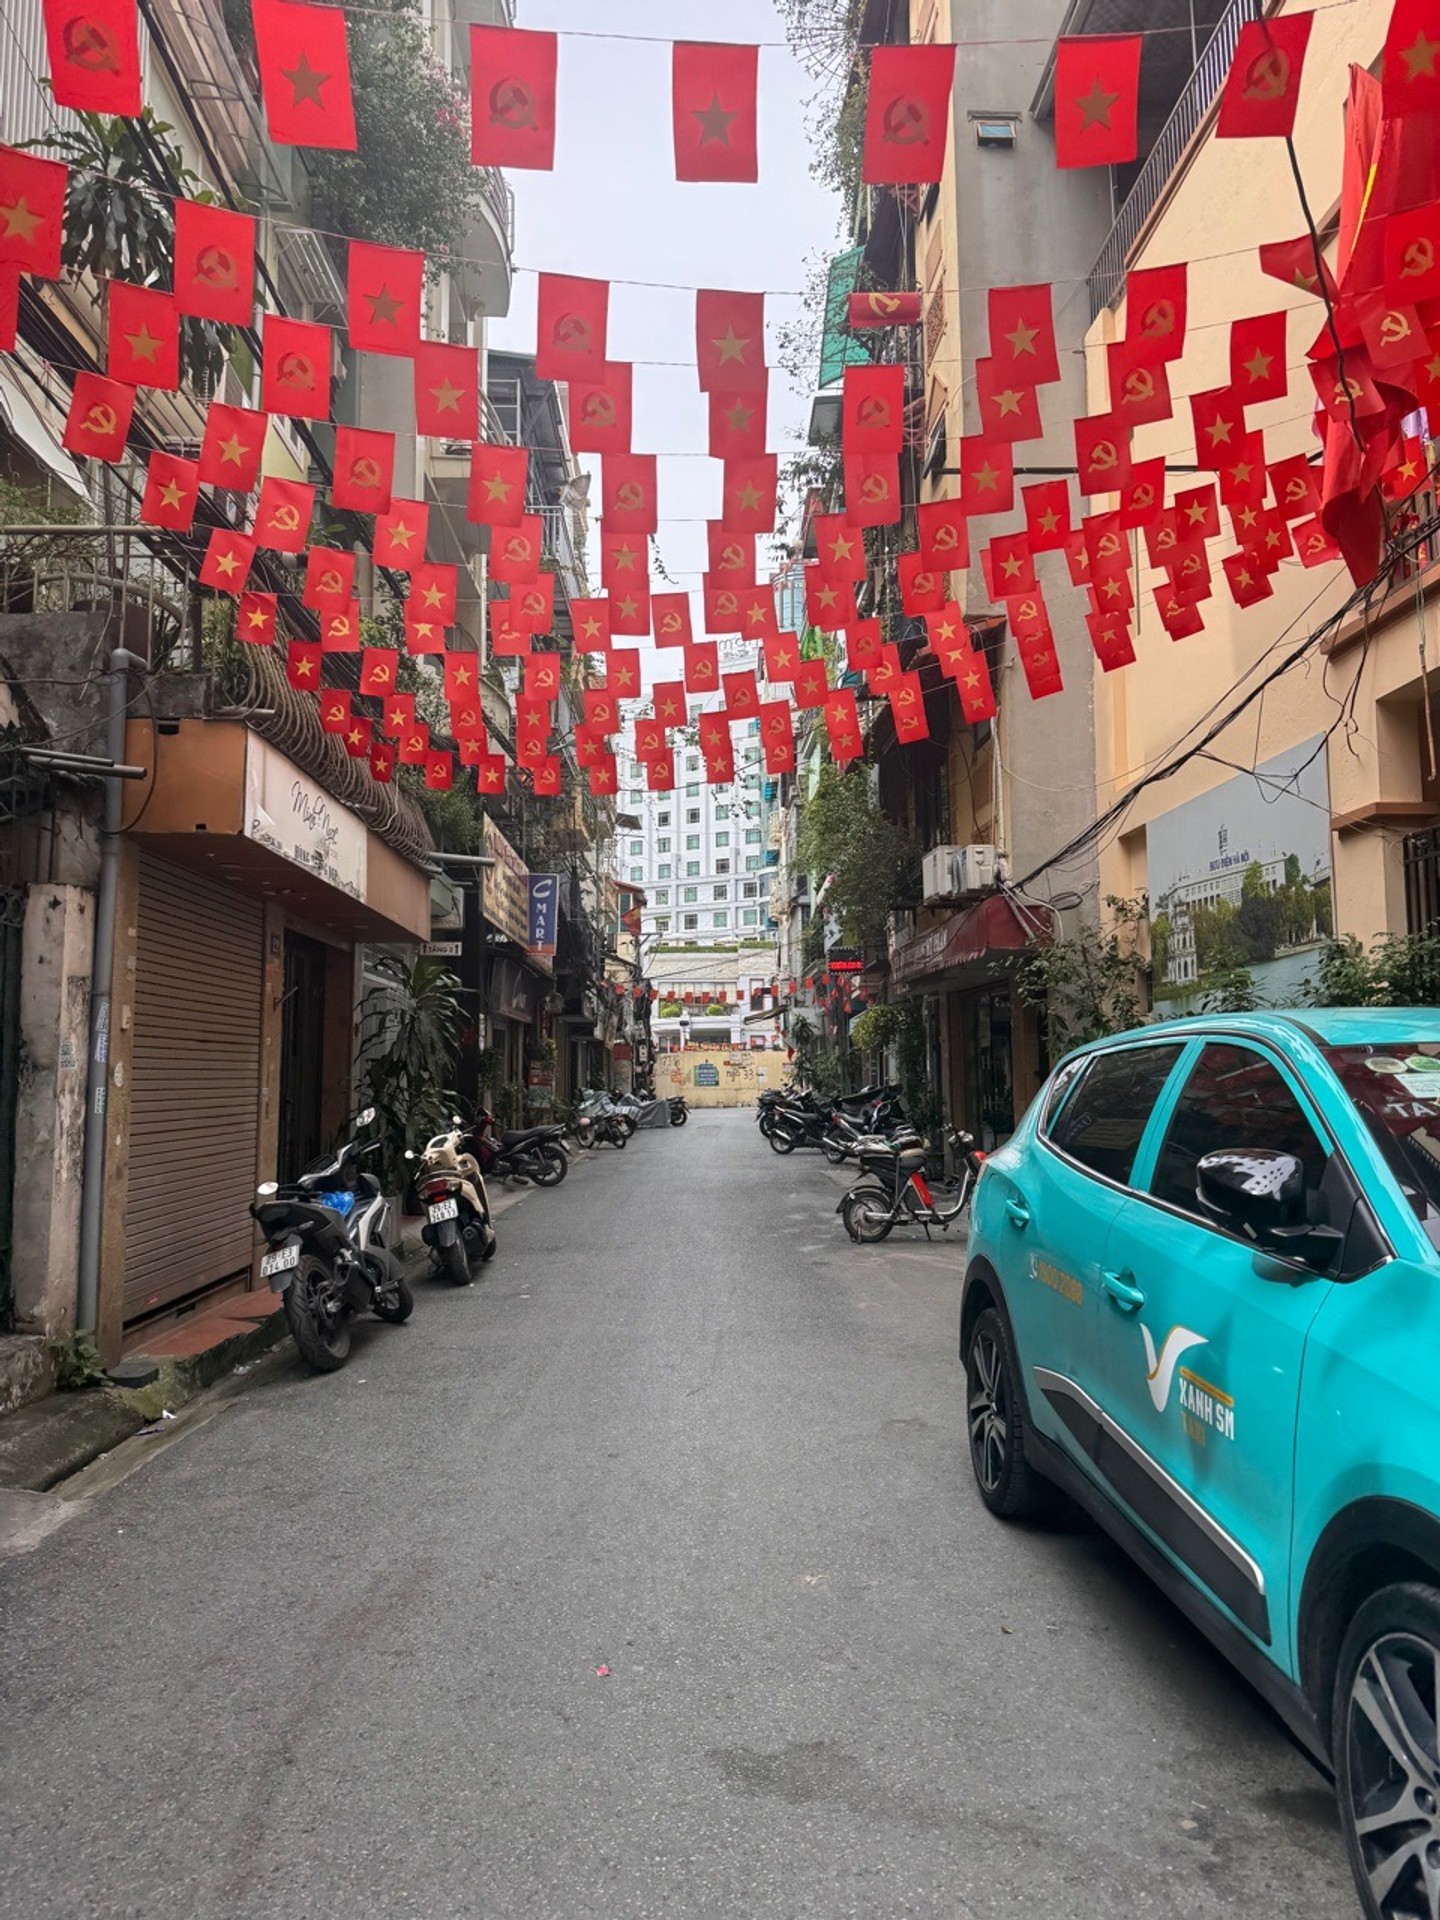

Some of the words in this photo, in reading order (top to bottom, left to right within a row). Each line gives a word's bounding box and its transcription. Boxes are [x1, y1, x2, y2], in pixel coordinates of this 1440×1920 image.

[532, 878, 553, 898] C
[535, 902, 548, 951] MART
[1179, 1377, 1214, 1426] XANH
[1214, 1402, 1235, 1441] SM
